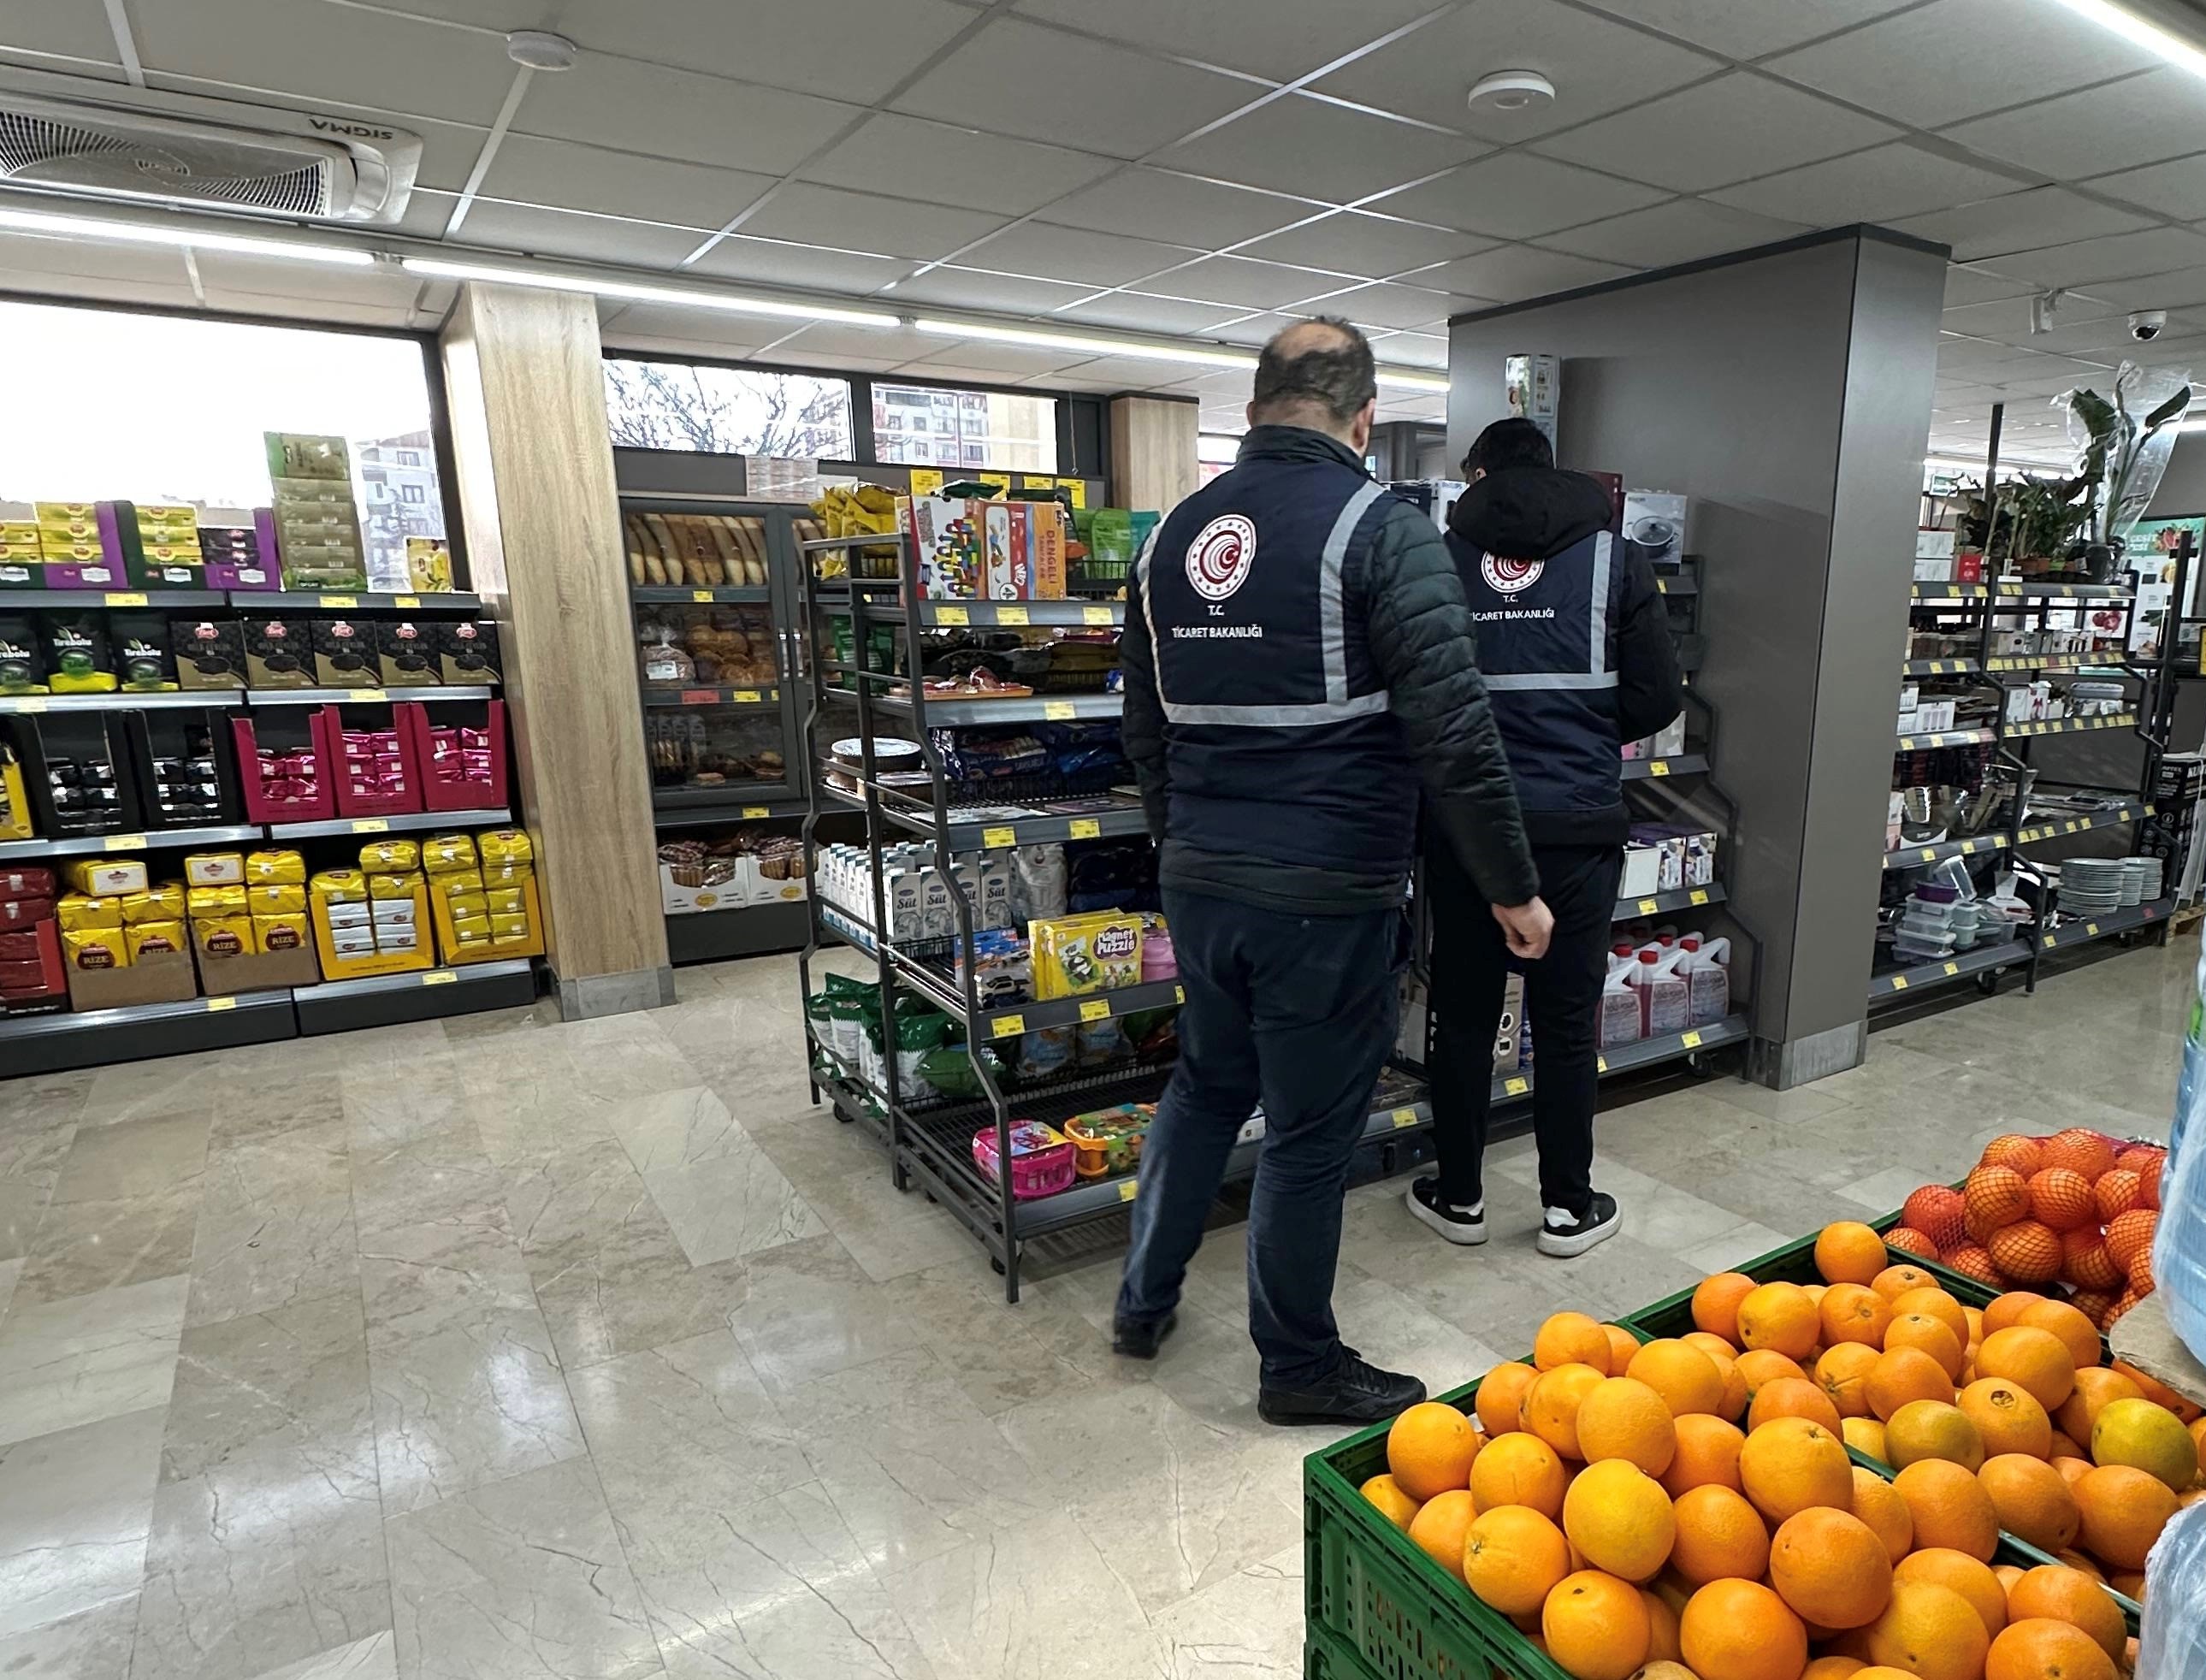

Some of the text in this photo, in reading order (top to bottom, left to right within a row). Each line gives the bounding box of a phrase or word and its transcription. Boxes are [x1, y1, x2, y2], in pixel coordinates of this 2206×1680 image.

[309, 118, 393, 140] SIGMA
[1503, 595, 1518, 603] T.C.
[1470, 606, 1555, 622] İCARET BAKANLIĞI
[1171, 623, 1263, 639] TİCARET BAKANLIĞI
[964, 890, 977, 901] üt
[987, 887, 1006, 898] Süt
[896, 897, 919, 909] Süt
[926, 894, 947, 905] Süt
[1097, 929, 1134, 944] Magnet
[1097, 939, 1135, 955] Puzzle
